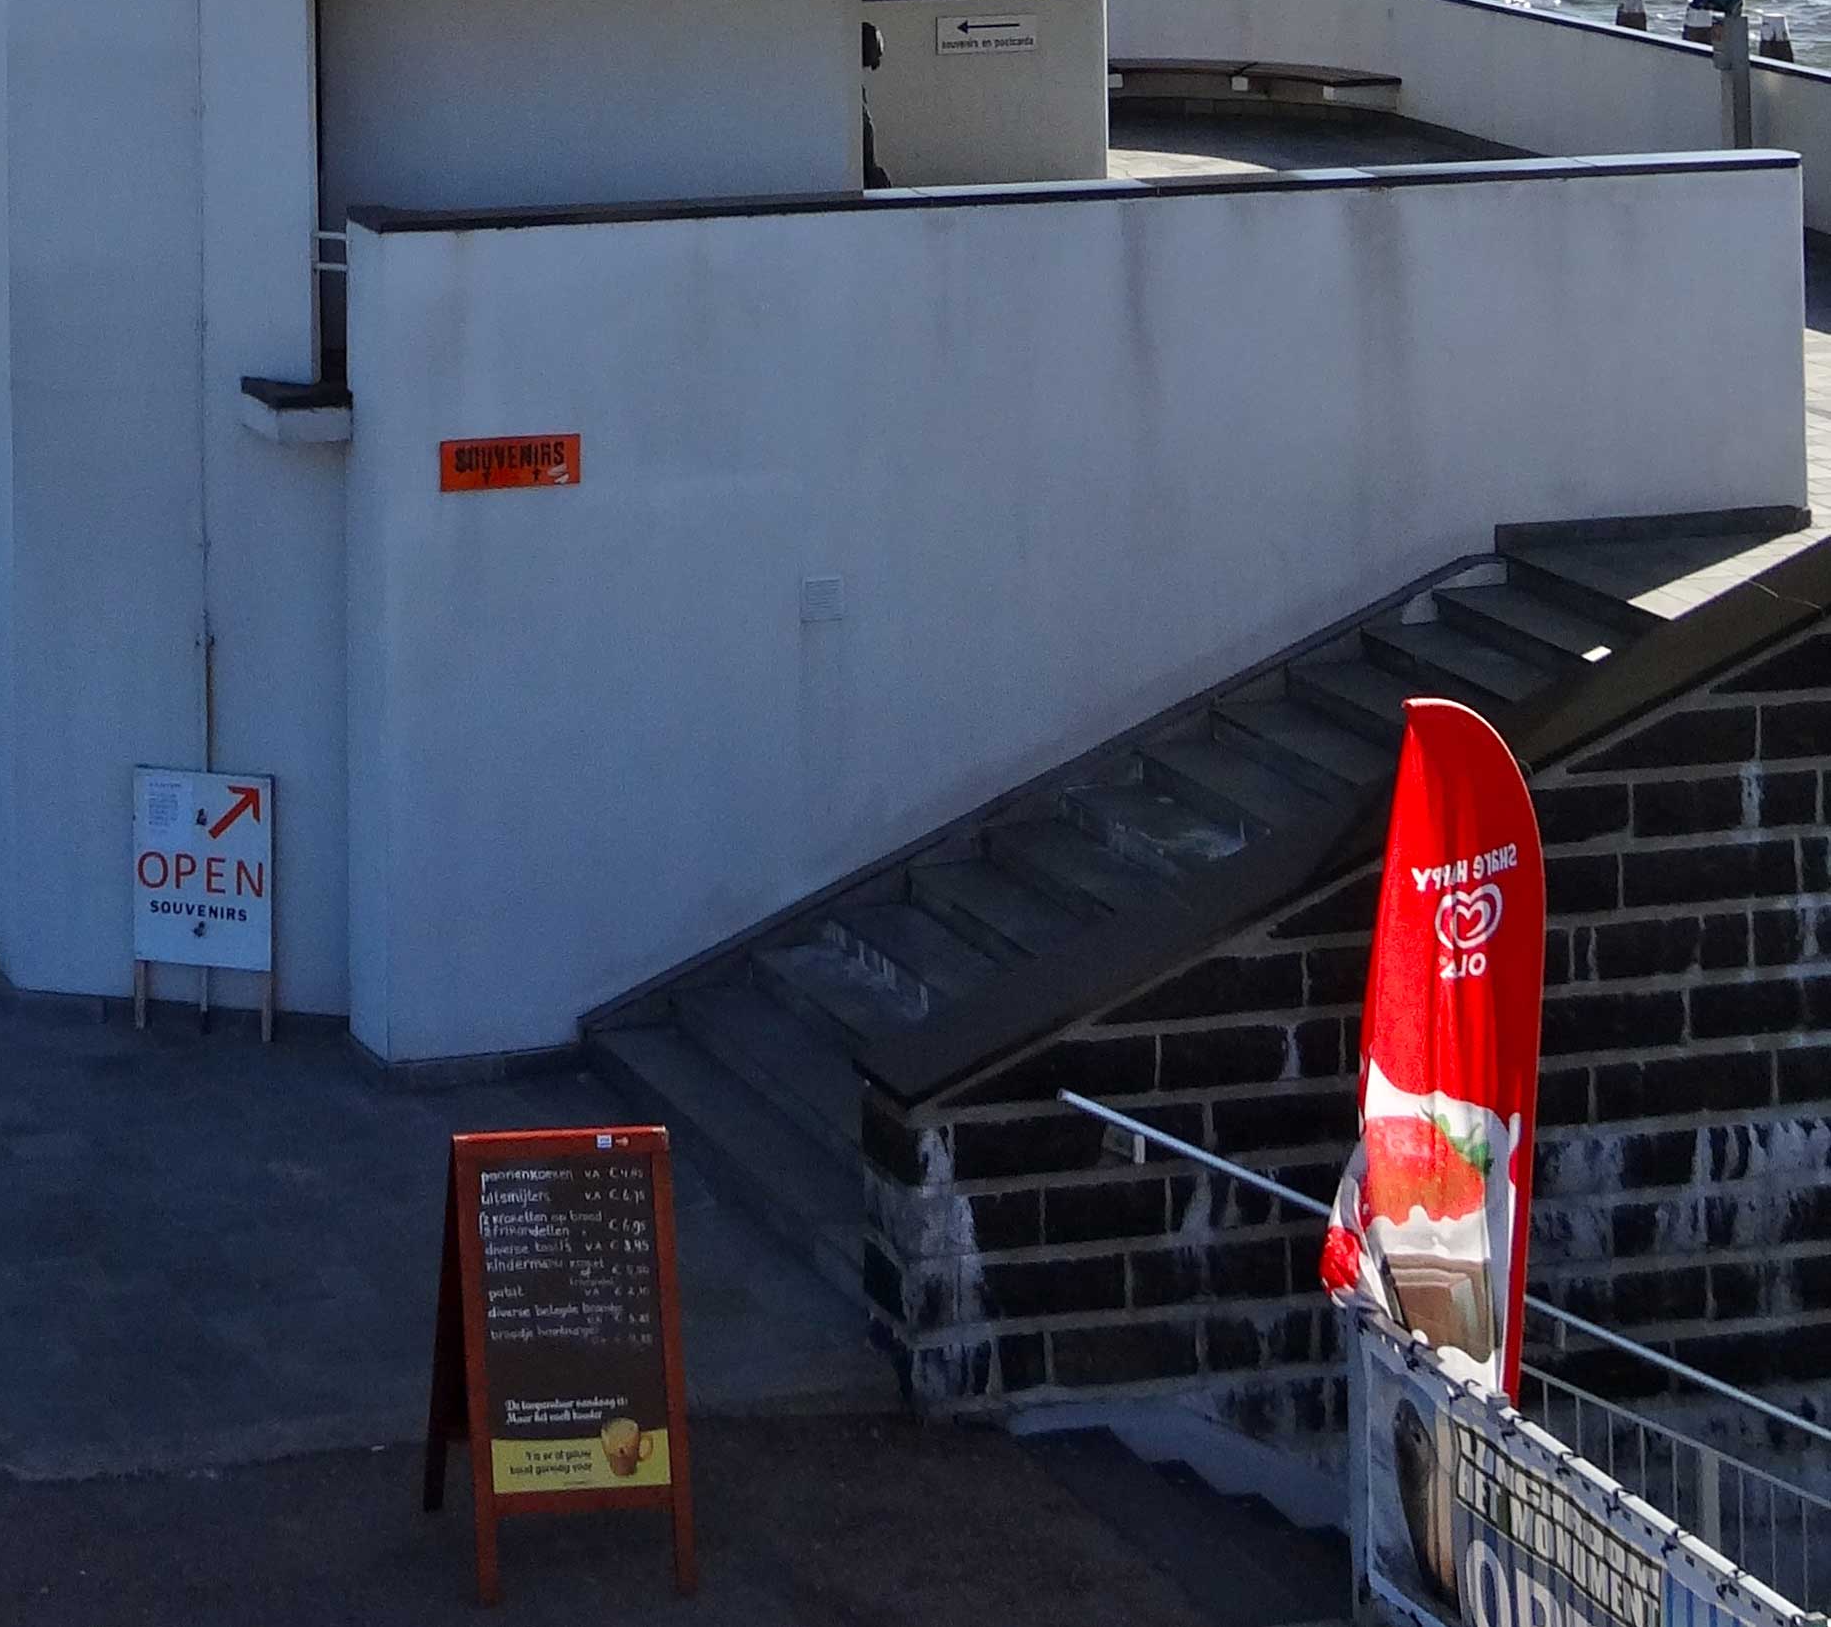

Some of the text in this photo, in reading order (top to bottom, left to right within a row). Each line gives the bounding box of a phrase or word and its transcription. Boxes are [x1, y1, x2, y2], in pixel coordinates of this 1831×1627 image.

[454, 441, 566, 473] SOUVENIRS
[137, 850, 265, 899] OPEN
[150, 900, 248, 922] SOUVENIRS
[1456, 1427, 1661, 1600] LUNCHROOM
[1510, 1492, 1661, 1627] MONUMENT
